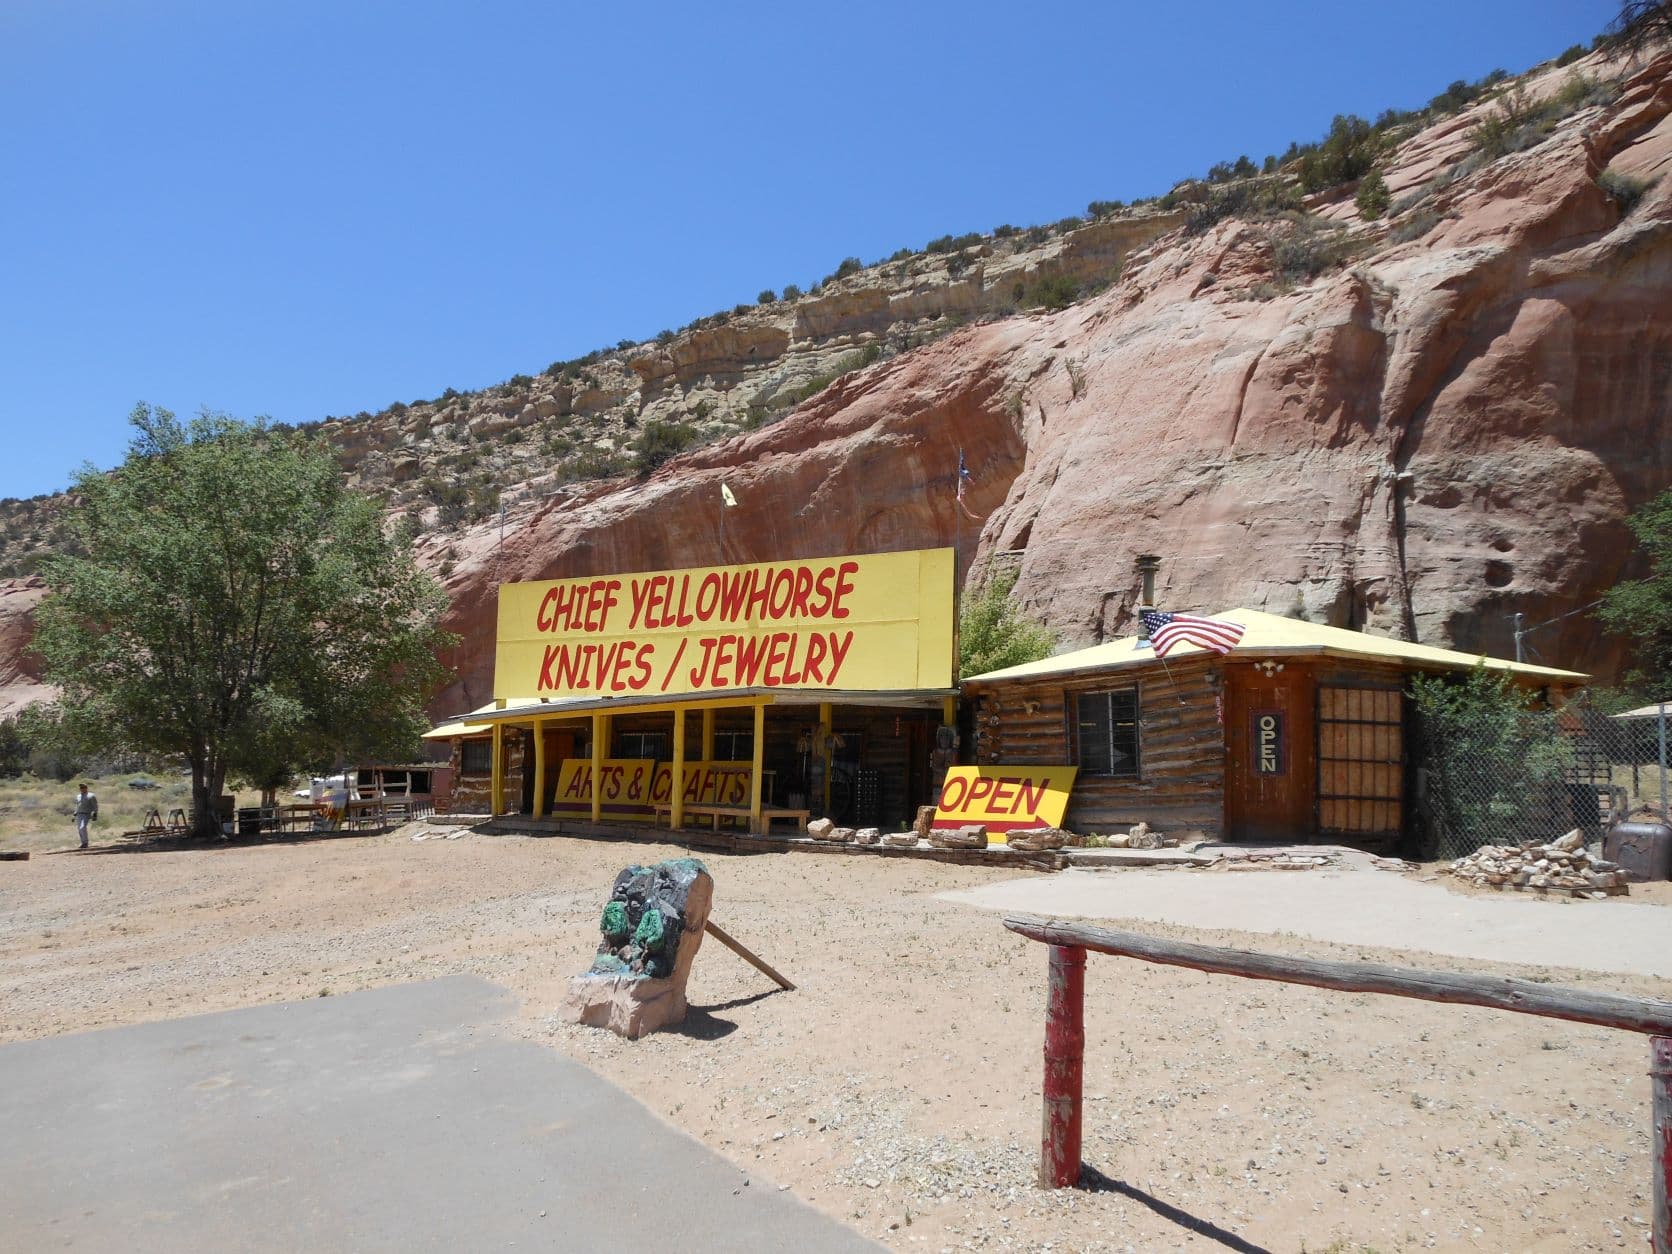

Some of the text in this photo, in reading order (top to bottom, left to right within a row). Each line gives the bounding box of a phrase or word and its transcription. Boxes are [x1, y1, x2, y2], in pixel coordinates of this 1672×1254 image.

[537, 562, 859, 632] CHIEF YELLOWHORSE
[538, 631, 854, 691] KNIVES / JEWELRY
[1260, 715, 1277, 772] OPEN
[627, 766, 644, 801] &
[938, 775, 1050, 815] OPEN
